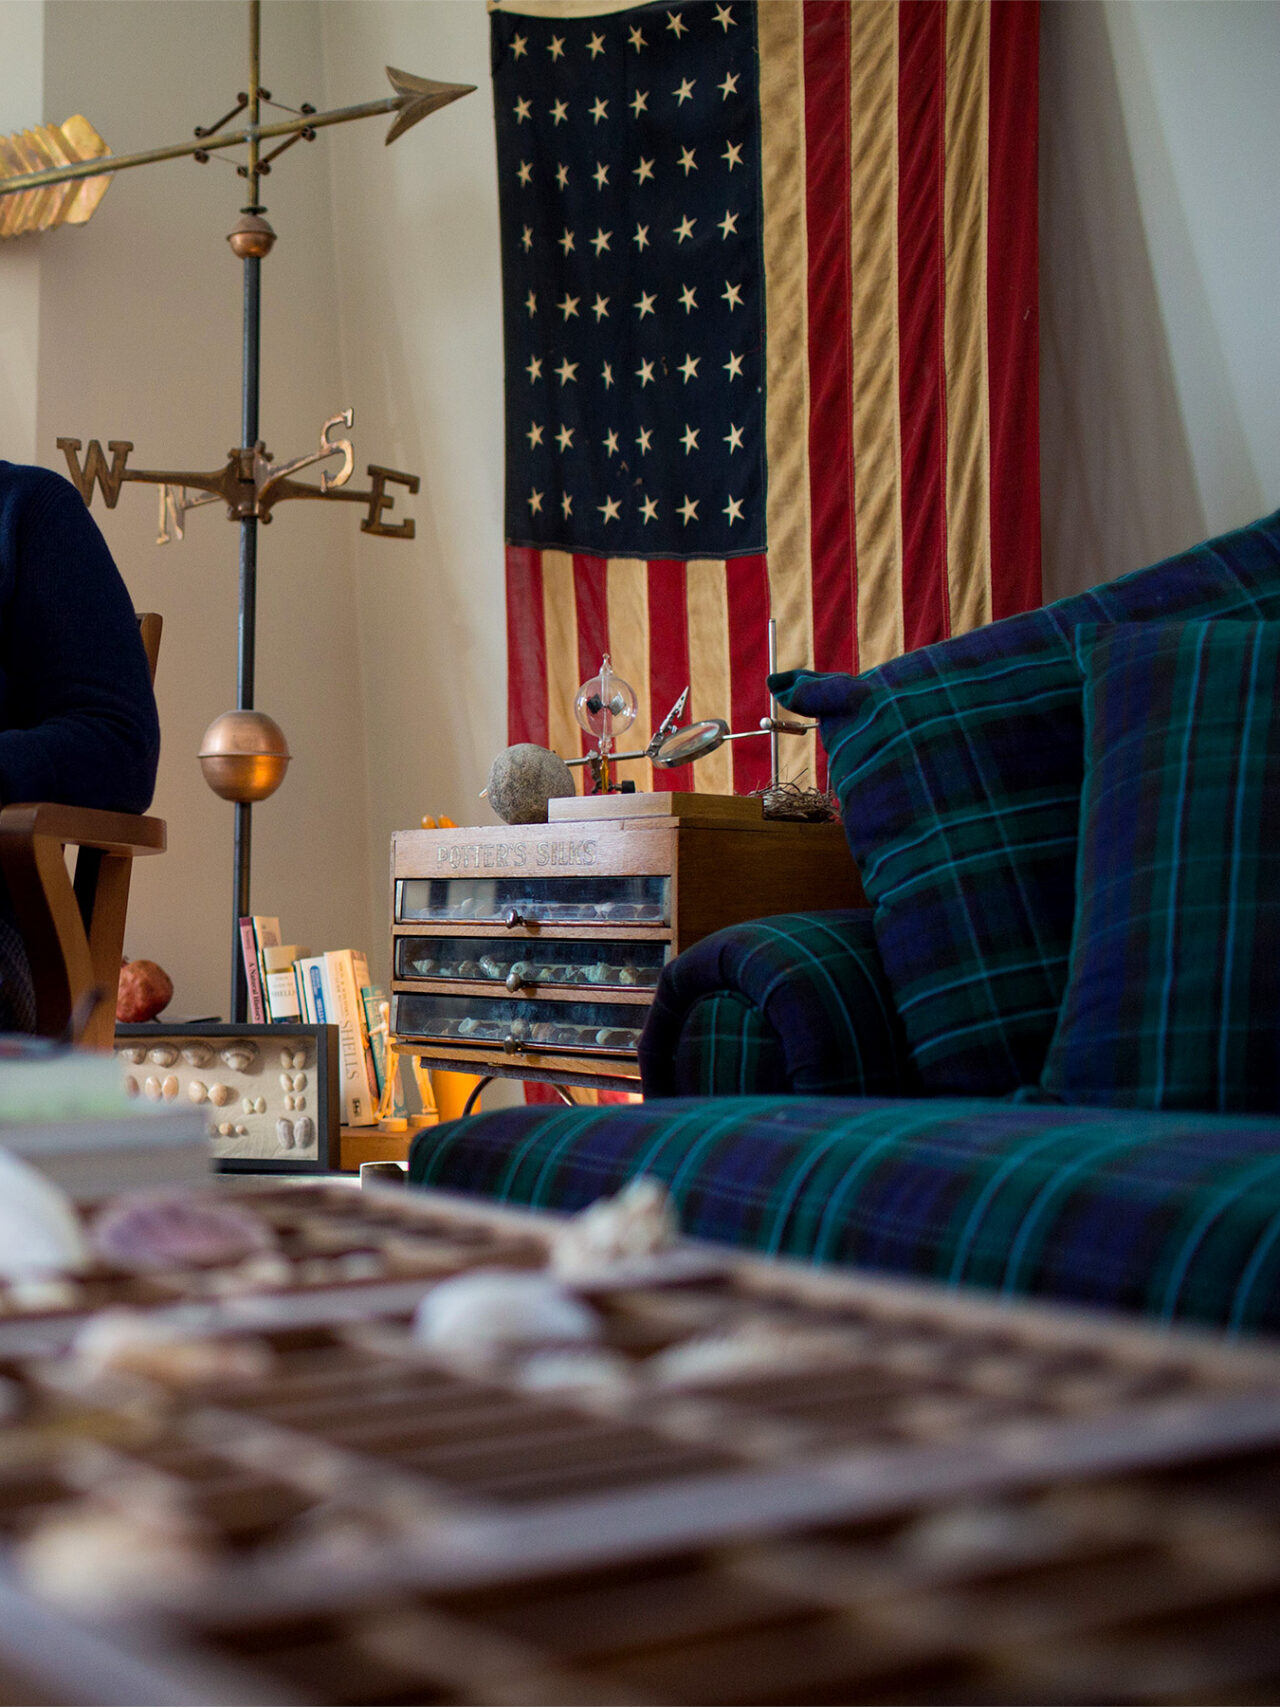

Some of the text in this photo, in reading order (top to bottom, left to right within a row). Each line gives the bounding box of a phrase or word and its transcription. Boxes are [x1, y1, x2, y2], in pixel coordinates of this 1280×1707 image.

[56, 437, 134, 509] W
[320, 407, 355, 493] S
[360, 464, 420, 540] E
[437, 839, 598, 869] POTTER'S SILKS
[250, 969, 259, 997] Natural
[340, 1019, 360, 1081] SHELLS
